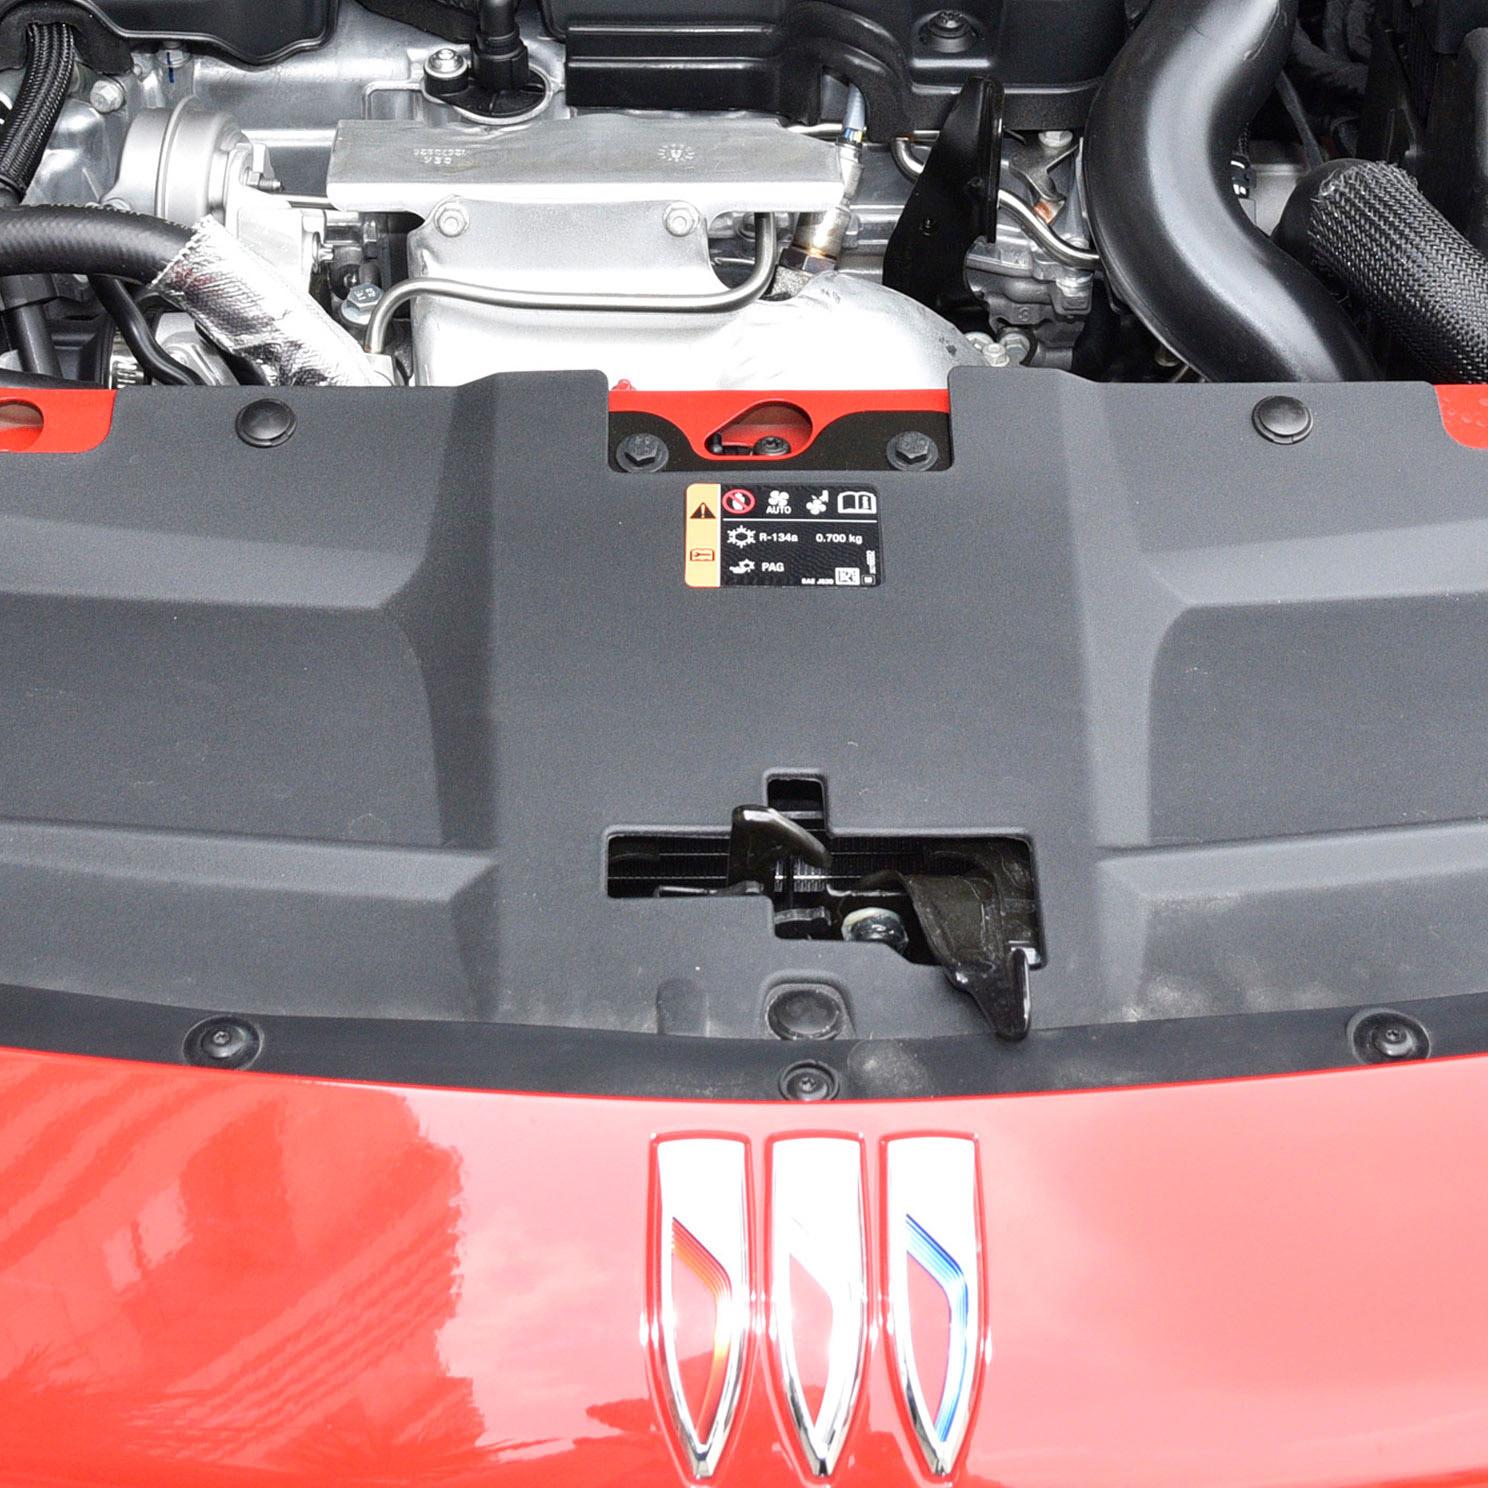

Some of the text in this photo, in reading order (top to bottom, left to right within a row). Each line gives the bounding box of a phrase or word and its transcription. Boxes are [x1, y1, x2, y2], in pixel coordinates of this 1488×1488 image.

[766, 505, 791, 514] AUTO
[759, 533, 863, 545] R-134a 0.700 kg
[761, 562, 784, 572] PAG
